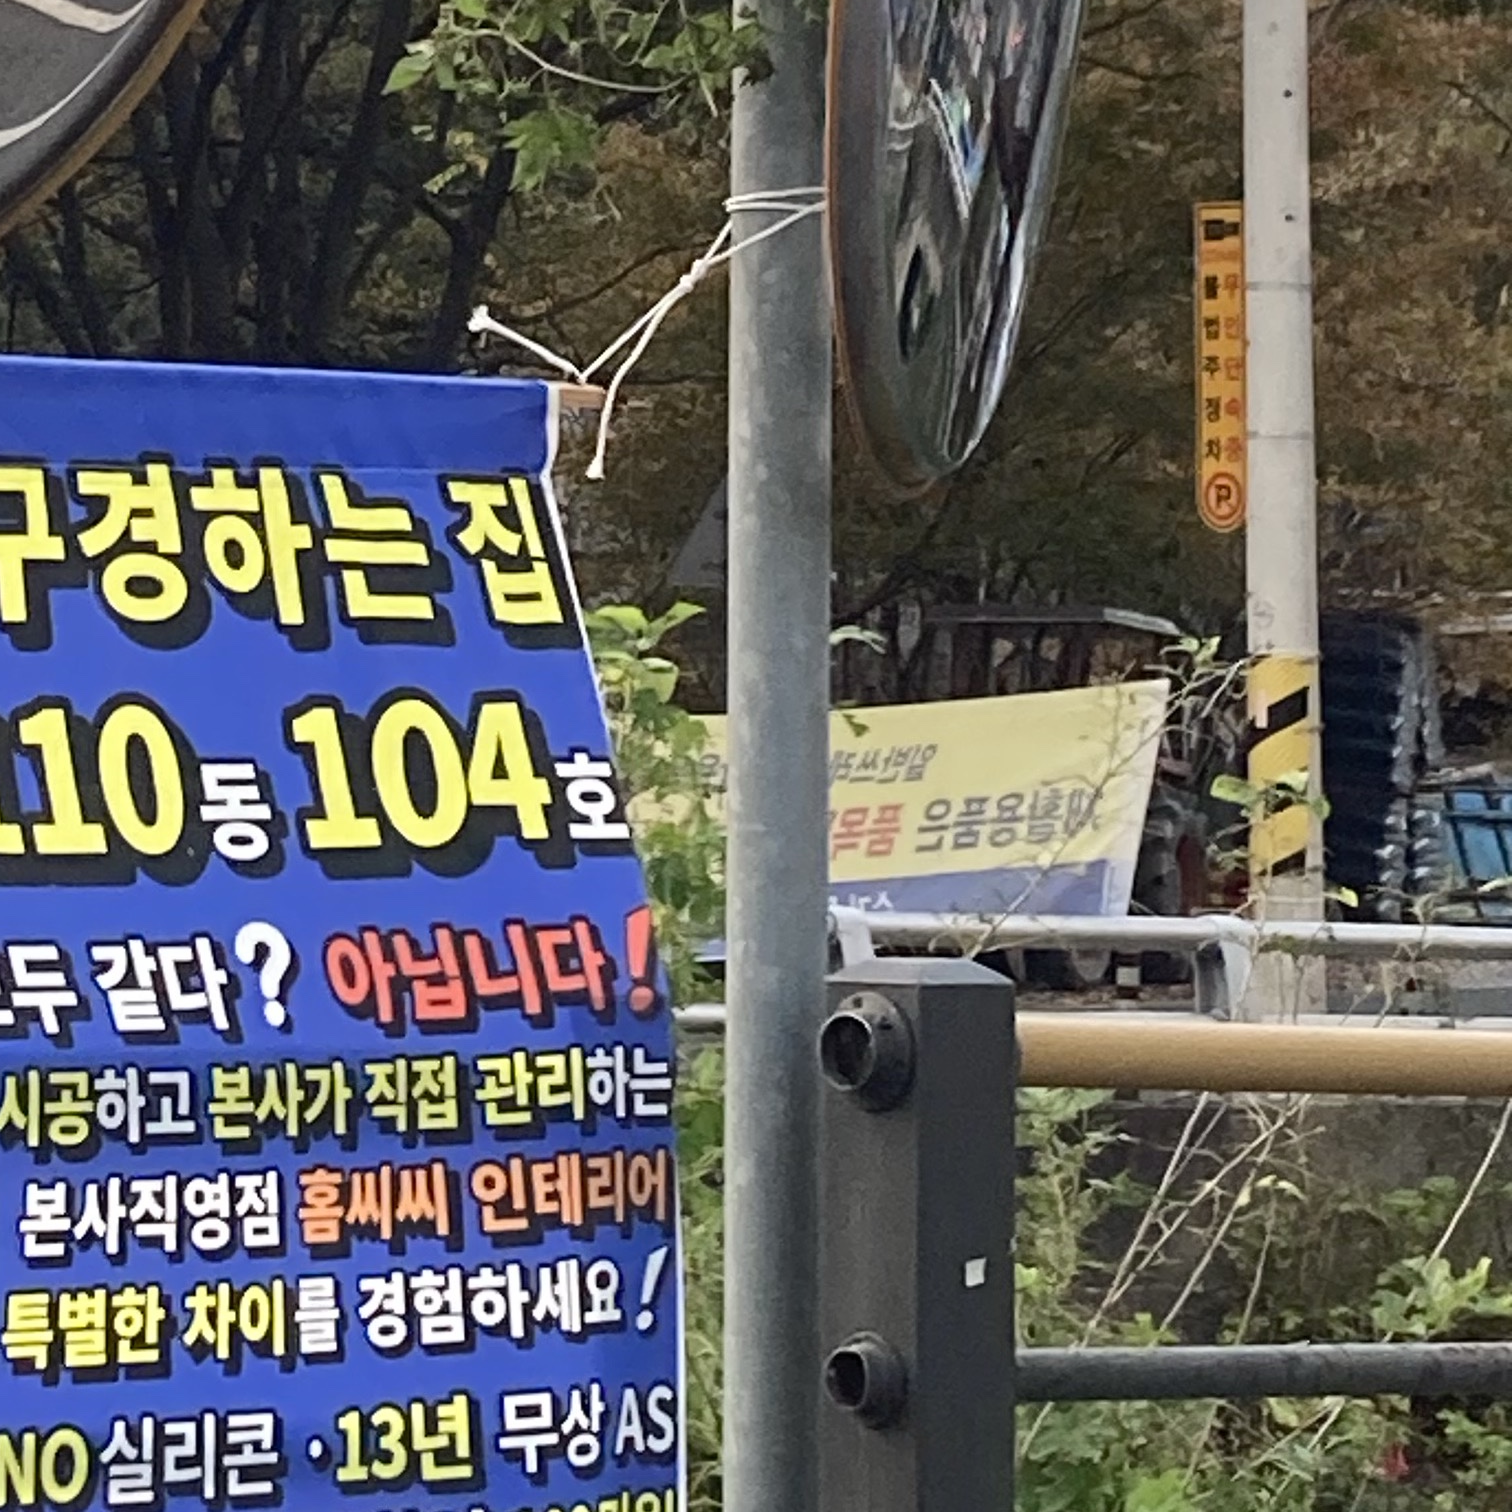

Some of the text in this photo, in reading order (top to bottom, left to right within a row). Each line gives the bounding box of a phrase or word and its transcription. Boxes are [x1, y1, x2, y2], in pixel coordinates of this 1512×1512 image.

[447, 476, 564, 623] 집
[292, 699, 631, 848] 104호
[91, 921, 291, 1031] 같다?
[326, 904, 655, 1023] 아닙니다!
[208, 1061, 351, 1139] 본사가
[364, 1055, 459, 1132] 직접
[475, 1045, 672, 1126] 관리하는
[19, 1171, 281, 1258] 본사직영점
[298, 1161, 449, 1244] 홈씨씨
[471, 1148, 666, 1232] 인테리어
[1, 1285, 166, 1368] 특별한
[182, 1278, 340, 1360] 차이를
[358, 1245, 668, 1348] 경험하세요!
